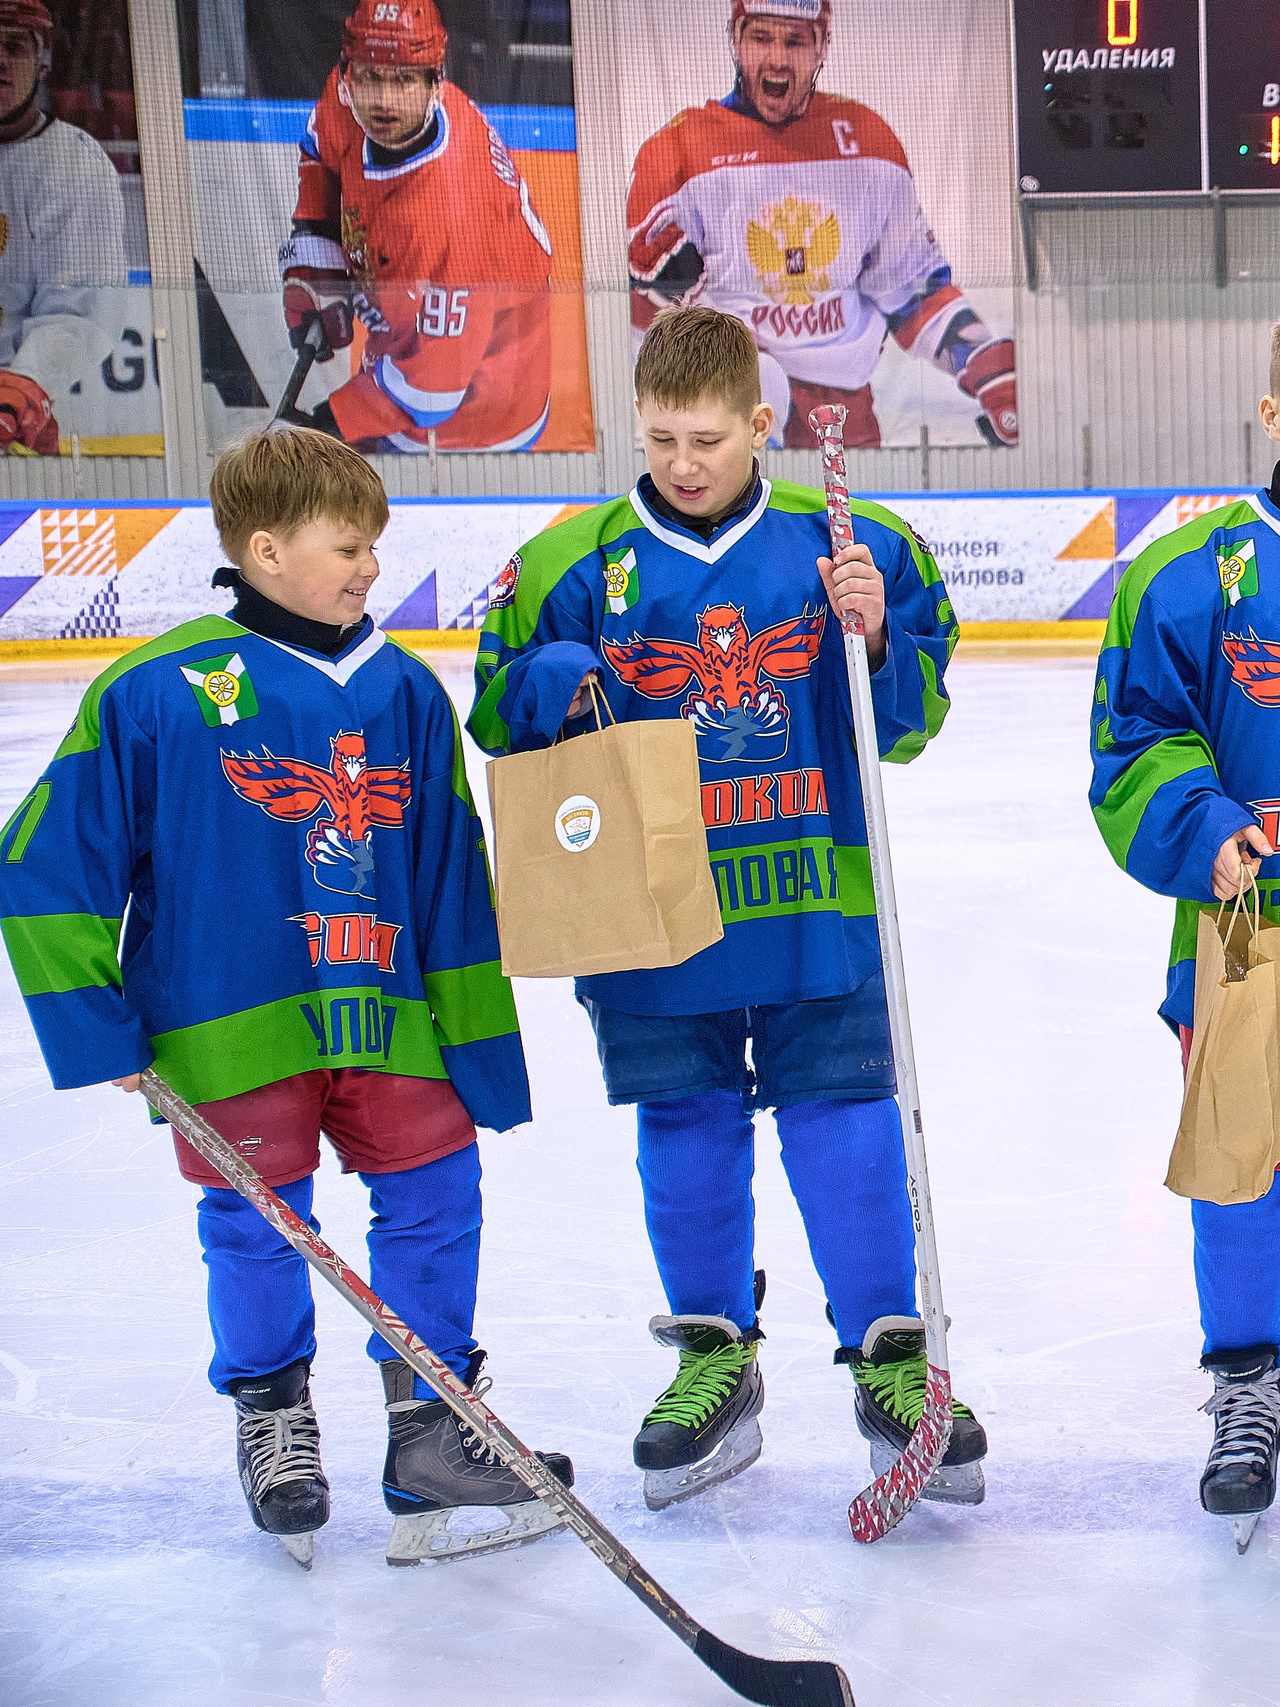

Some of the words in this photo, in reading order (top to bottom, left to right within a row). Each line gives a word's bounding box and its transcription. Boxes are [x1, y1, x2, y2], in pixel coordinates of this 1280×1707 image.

[1107, 0, 1138, 46] 0
[1042, 47, 1176, 73] УДАЛЕНИЯ
[422, 287, 470, 337] 95
[751, 296, 846, 338] РОССИЯ
[700, 767, 829, 829] ОКОЛ
